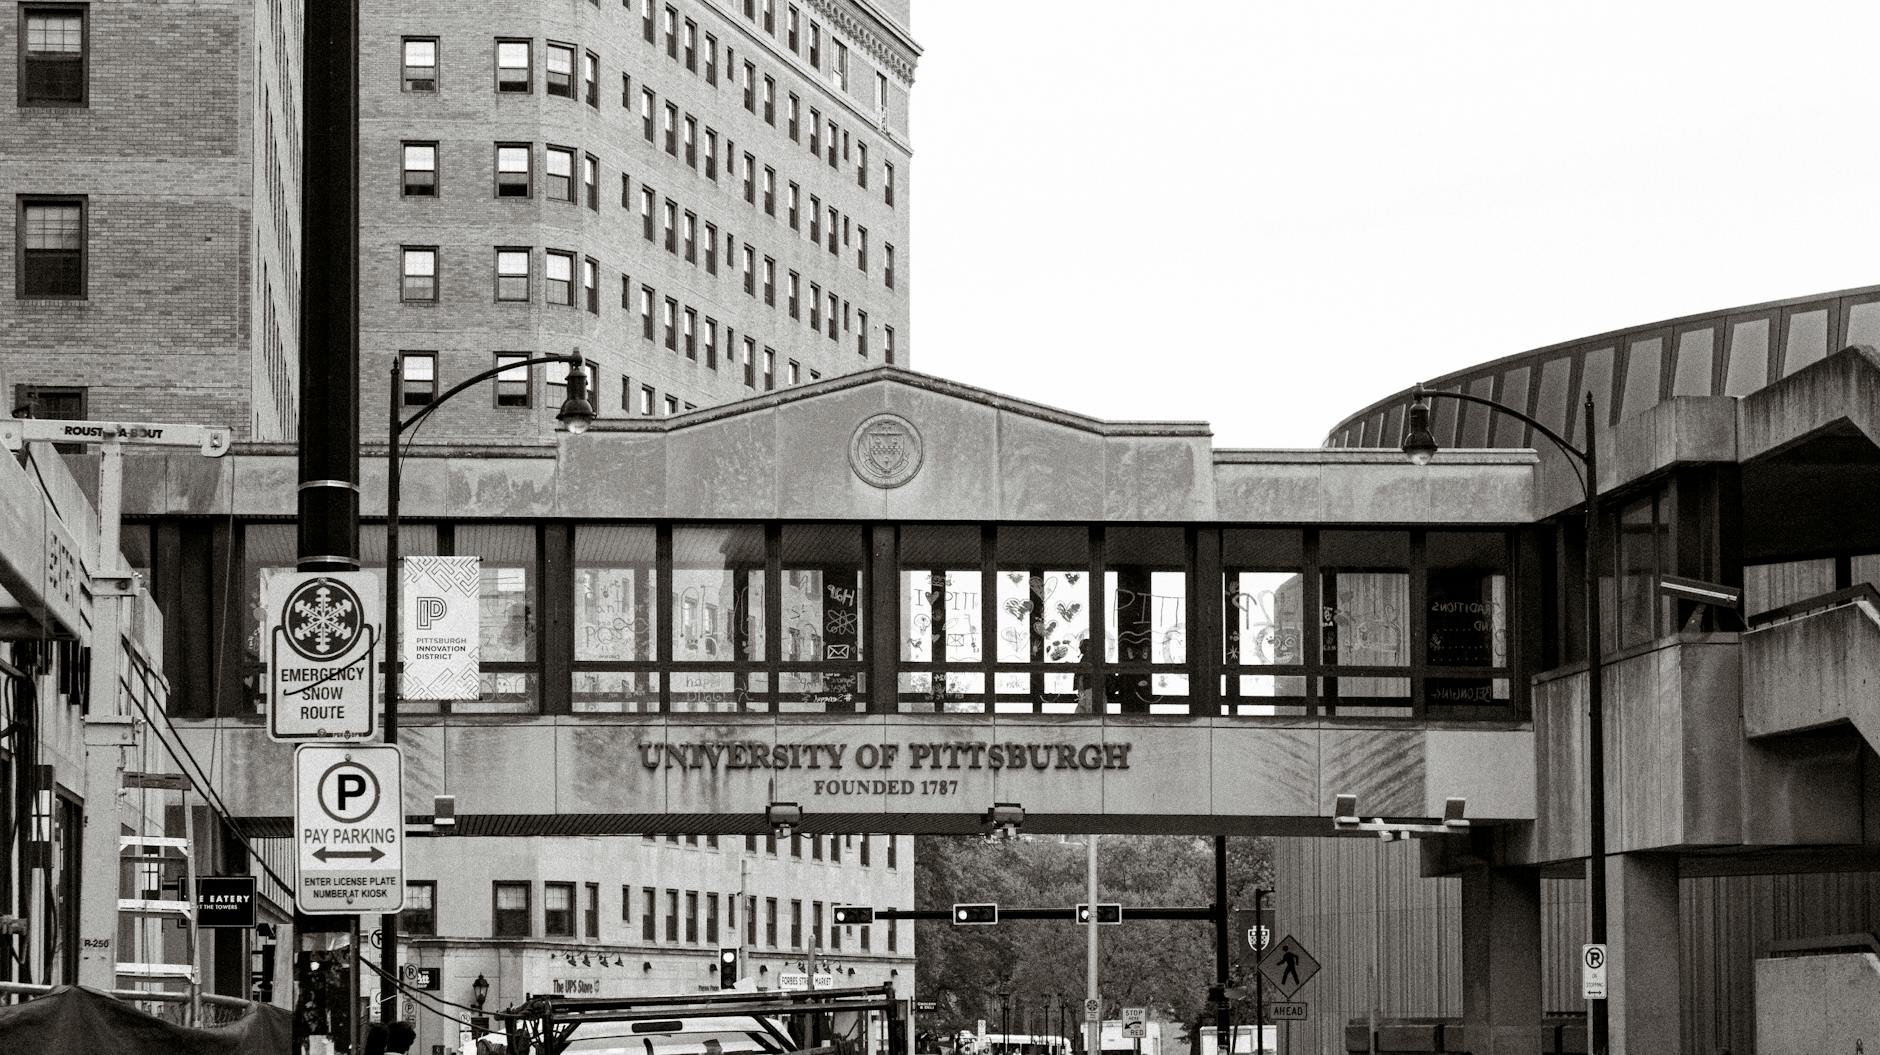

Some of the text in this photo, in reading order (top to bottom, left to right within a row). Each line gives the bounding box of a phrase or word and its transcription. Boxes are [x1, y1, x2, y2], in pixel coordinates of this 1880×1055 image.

[281, 667, 365, 682] EMERGENCY
[302, 686, 343, 700] SNOW
[300, 706, 345, 719] ROUTE
[638, 741, 1133, 771] UNIVERSITY OF PITTSBURGH
[337, 774, 367, 810] P
[814, 779, 959, 796] FOUNDED 1787
[304, 828, 396, 844] PAY PARKING
[304, 876, 396, 887] ENTER LICENSE PLATE
[209, 894, 250, 903] EATERY
[313, 889, 388, 898] NUMBER AT KIOSK
[84, 939, 108, 948] R-250
[553, 979, 564, 993] The
[565, 979, 577, 993] UPS
[1125, 1009, 1143, 1017] STOP
[1273, 1006, 1303, 1016] AHEAD
